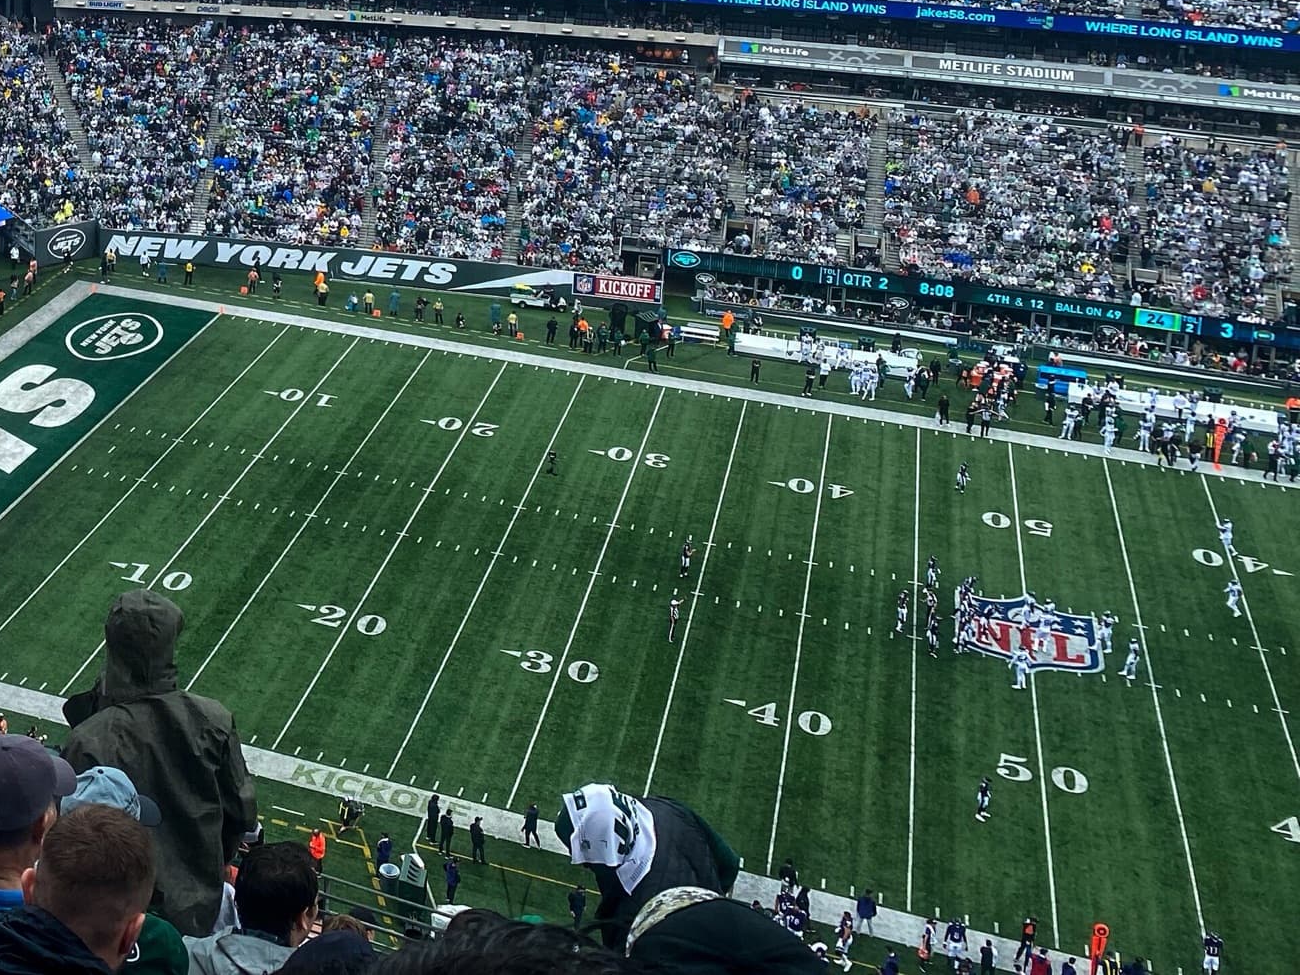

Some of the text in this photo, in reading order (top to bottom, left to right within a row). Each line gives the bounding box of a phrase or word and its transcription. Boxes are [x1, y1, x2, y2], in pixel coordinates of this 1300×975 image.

[803, 0, 849, 12] ISLAND
[852, 2, 887, 15] WINS
[916, 6, 995, 23] jakes58.com
[360, 13, 386, 23] MetLife
[1085, 20, 1283, 48] WHERE LONG ISLAND WINS
[761, 44, 809, 57] MetLife
[939, 59, 1074, 82] METLIFE STADIUM
[1243, 88, 1300, 101] MetLife
[103, 235, 458, 285] NEW YORK JETS
[791, 268, 803, 280] 0
[826, 275, 833, 284] 3
[843, 273, 888, 290] QTR 2
[599, 279, 651, 298] KICKOFF
[919, 282, 954, 298] 8:08
[987, 293, 1044, 309] 4TH & 12
[1055, 302, 1122, 320] BALL ON 49
[1147, 313, 1165, 326] 24
[79, 319, 117, 347] NEW YORK
[94, 318, 141, 354] JETS
[1185, 323, 1194, 333] 2
[1220, 322, 1234, 339] 3
[974, 617, 1085, 665] NFL
[996, 753, 1089, 794] 50
